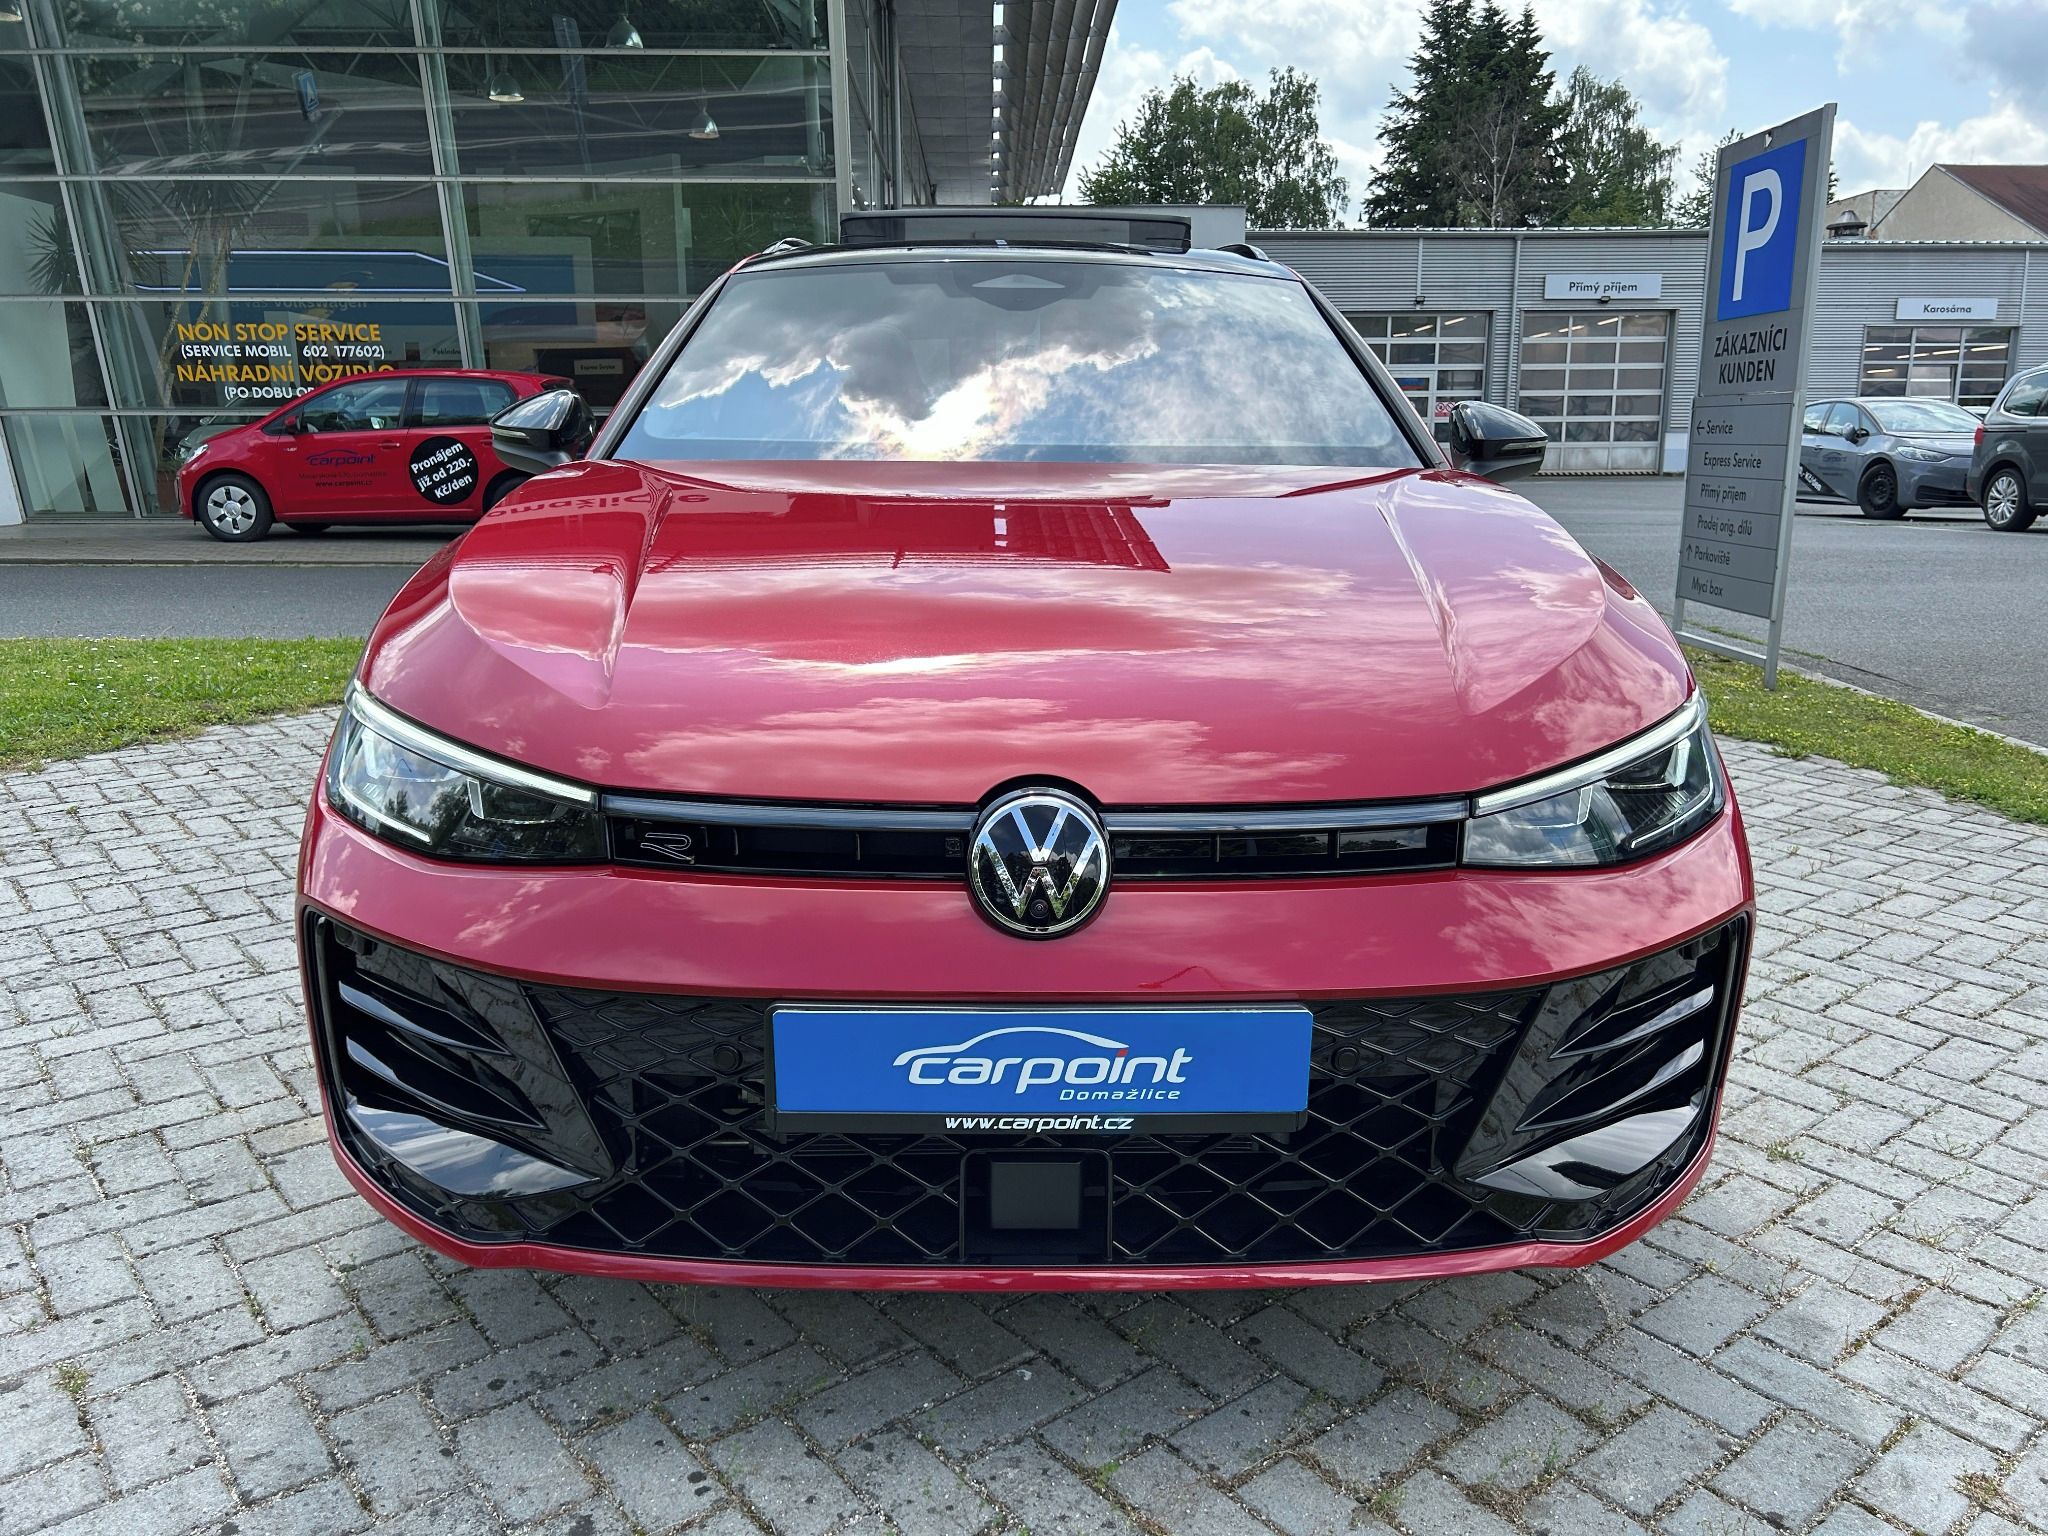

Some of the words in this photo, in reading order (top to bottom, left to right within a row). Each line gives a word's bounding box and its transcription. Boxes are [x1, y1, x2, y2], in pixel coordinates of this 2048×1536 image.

[1732, 168, 1783, 302] P
[1569, 281, 1600, 294] Přímý
[1603, 281, 1638, 294] příjem
[1923, 304, 1972, 313] Karosárna
[177, 323, 230, 341] NON
[236, 323, 289, 341] STOP
[294, 323, 382, 341] SERVICE
[1714, 324, 1788, 358] ZÁKAZNÍCI
[181, 344, 241, 359] (SERVICE
[245, 345, 291, 357] MOBIL
[302, 345, 329, 357] 602
[334, 344, 385, 360] 177602)
[176, 360, 295, 382] NÁHRADNÍ
[299, 364, 395, 383] VOZI
[1718, 359, 1776, 385] KUNDEN
[224, 386, 248, 400] (PO
[251, 386, 293, 399] DOBU
[1706, 419, 1734, 435] Service
[410, 442, 464, 474] Pronájem
[1703, 451, 1731, 470] Express
[1732, 452, 1762, 469] Service
[417, 475, 433, 492] již
[432, 467, 447, 482] od
[446, 458, 473, 475] 220,-
[434, 475, 473, 499] Kč/den
[1700, 483, 1721, 503] Přímý
[1721, 485, 1747, 504] příjem
[1697, 514, 1719, 535] Prodej
[1719, 519, 1736, 537] orig.
[1737, 519, 1753, 536] dílů
[1694, 545, 1731, 566] Parkoviště
[1709, 578, 1724, 597] box
[907, 1044, 1193, 1095] carpoint
[1059, 1088, 1181, 1101] Domažlice
[944, 1114, 1135, 1134] www.carpoint.cz
